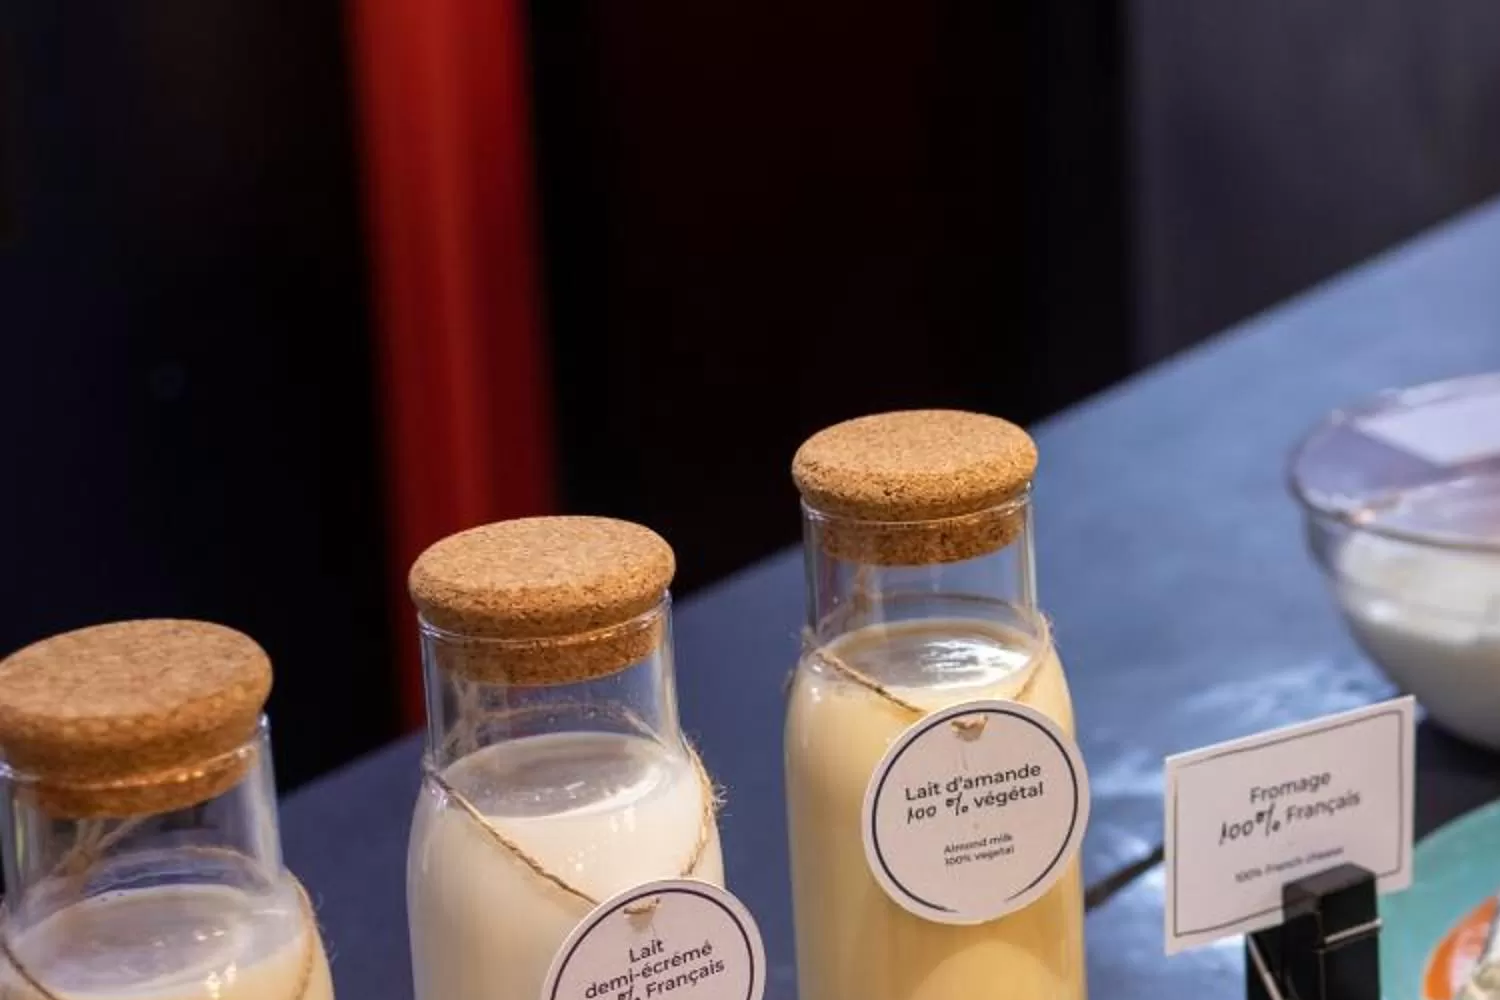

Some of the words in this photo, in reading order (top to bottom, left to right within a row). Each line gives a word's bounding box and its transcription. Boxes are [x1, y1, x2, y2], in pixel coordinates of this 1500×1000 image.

[905, 781, 942, 802] Lait
[946, 763, 1042, 793] d'amande
[974, 782, 1044, 807] végétal
[1250, 771, 1332, 804] Fromage
[1286, 789, 1361, 824] Français
[629, 939, 665, 963] Lait
[585, 939, 713, 999] demi-écrémé
[646, 959, 726, 999] Français
